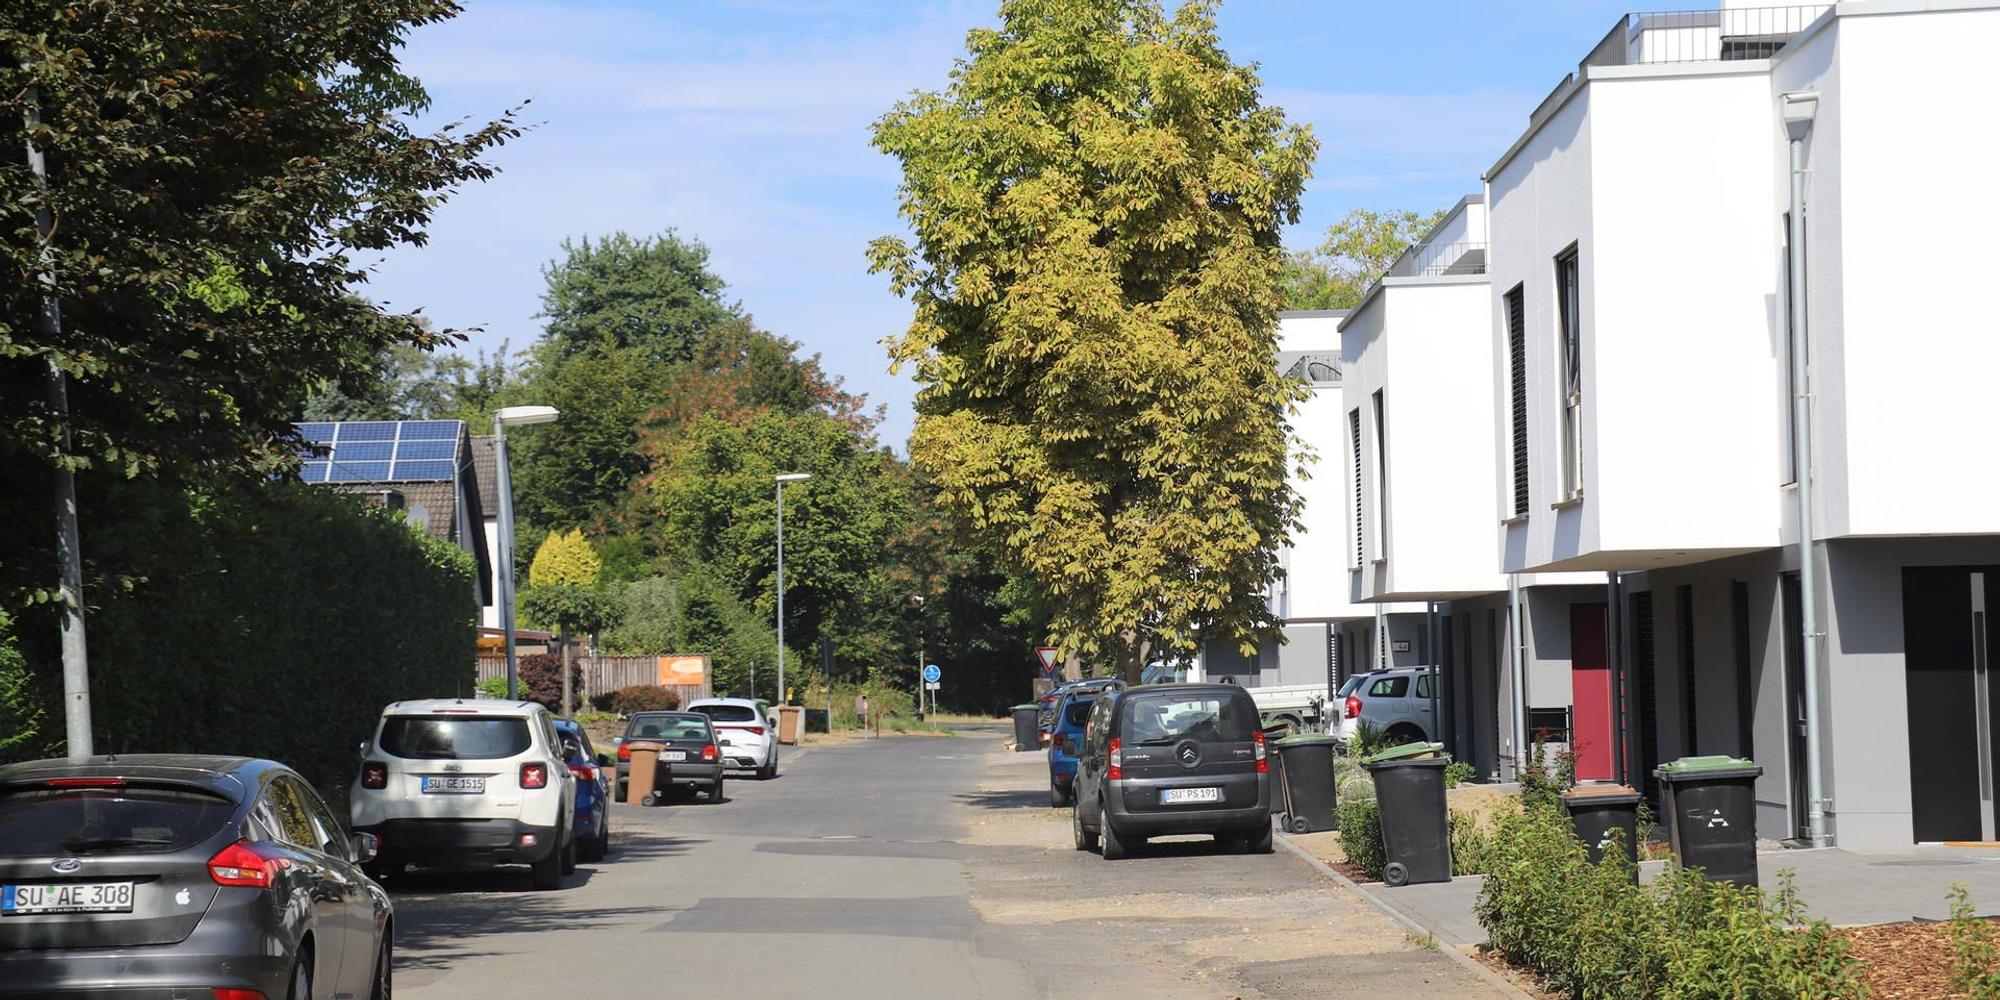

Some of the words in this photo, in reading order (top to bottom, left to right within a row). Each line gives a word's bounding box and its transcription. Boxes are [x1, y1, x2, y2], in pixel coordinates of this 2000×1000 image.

[429, 779, 440, 789] SU
[447, 779, 459, 789] GE
[460, 779, 483, 789] 1515
[1170, 791, 1182, 799] SU
[1187, 790, 1199, 798] PS
[1200, 789, 1216, 798] 191
[16, 887, 43, 906] SU
[57, 886, 84, 905] AE
[91, 885, 129, 904] 308
